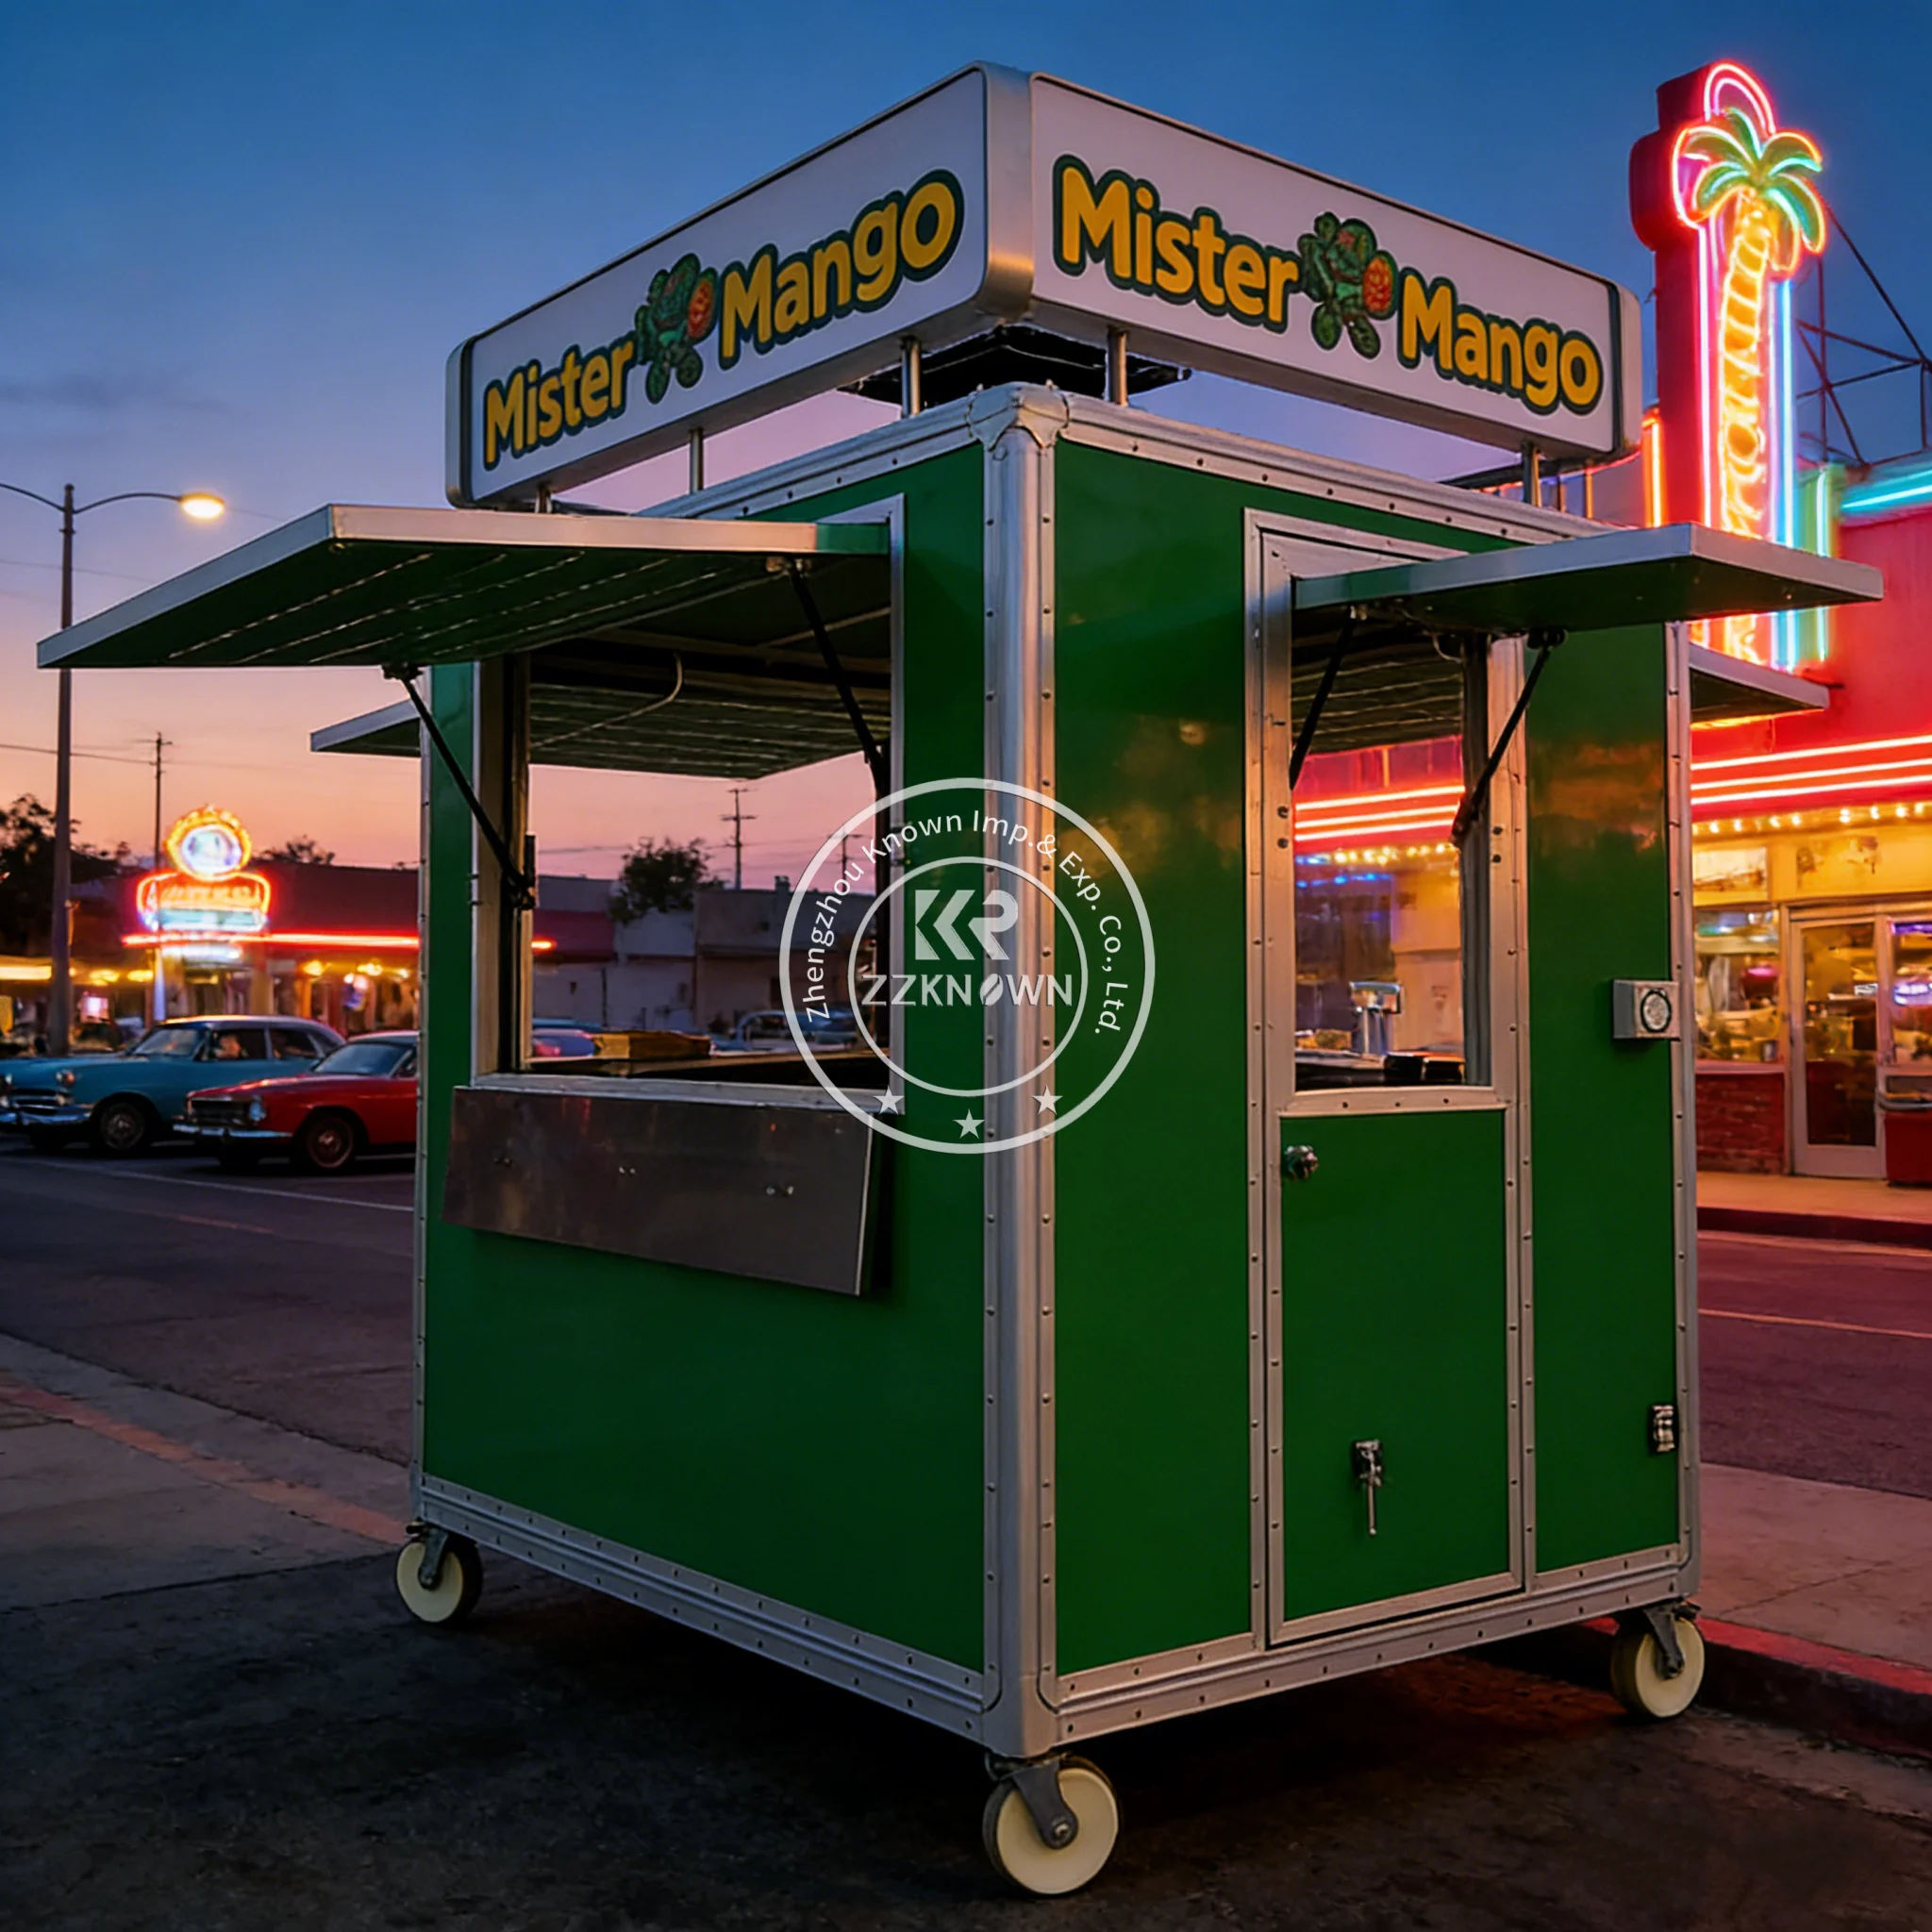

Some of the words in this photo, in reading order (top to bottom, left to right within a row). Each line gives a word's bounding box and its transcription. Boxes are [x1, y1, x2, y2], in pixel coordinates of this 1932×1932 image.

[484, 333, 638, 470] Mister
[719, 171, 963, 369] Mango
[1055, 157, 1302, 332] Mister
[1398, 268, 1602, 414] Mango
